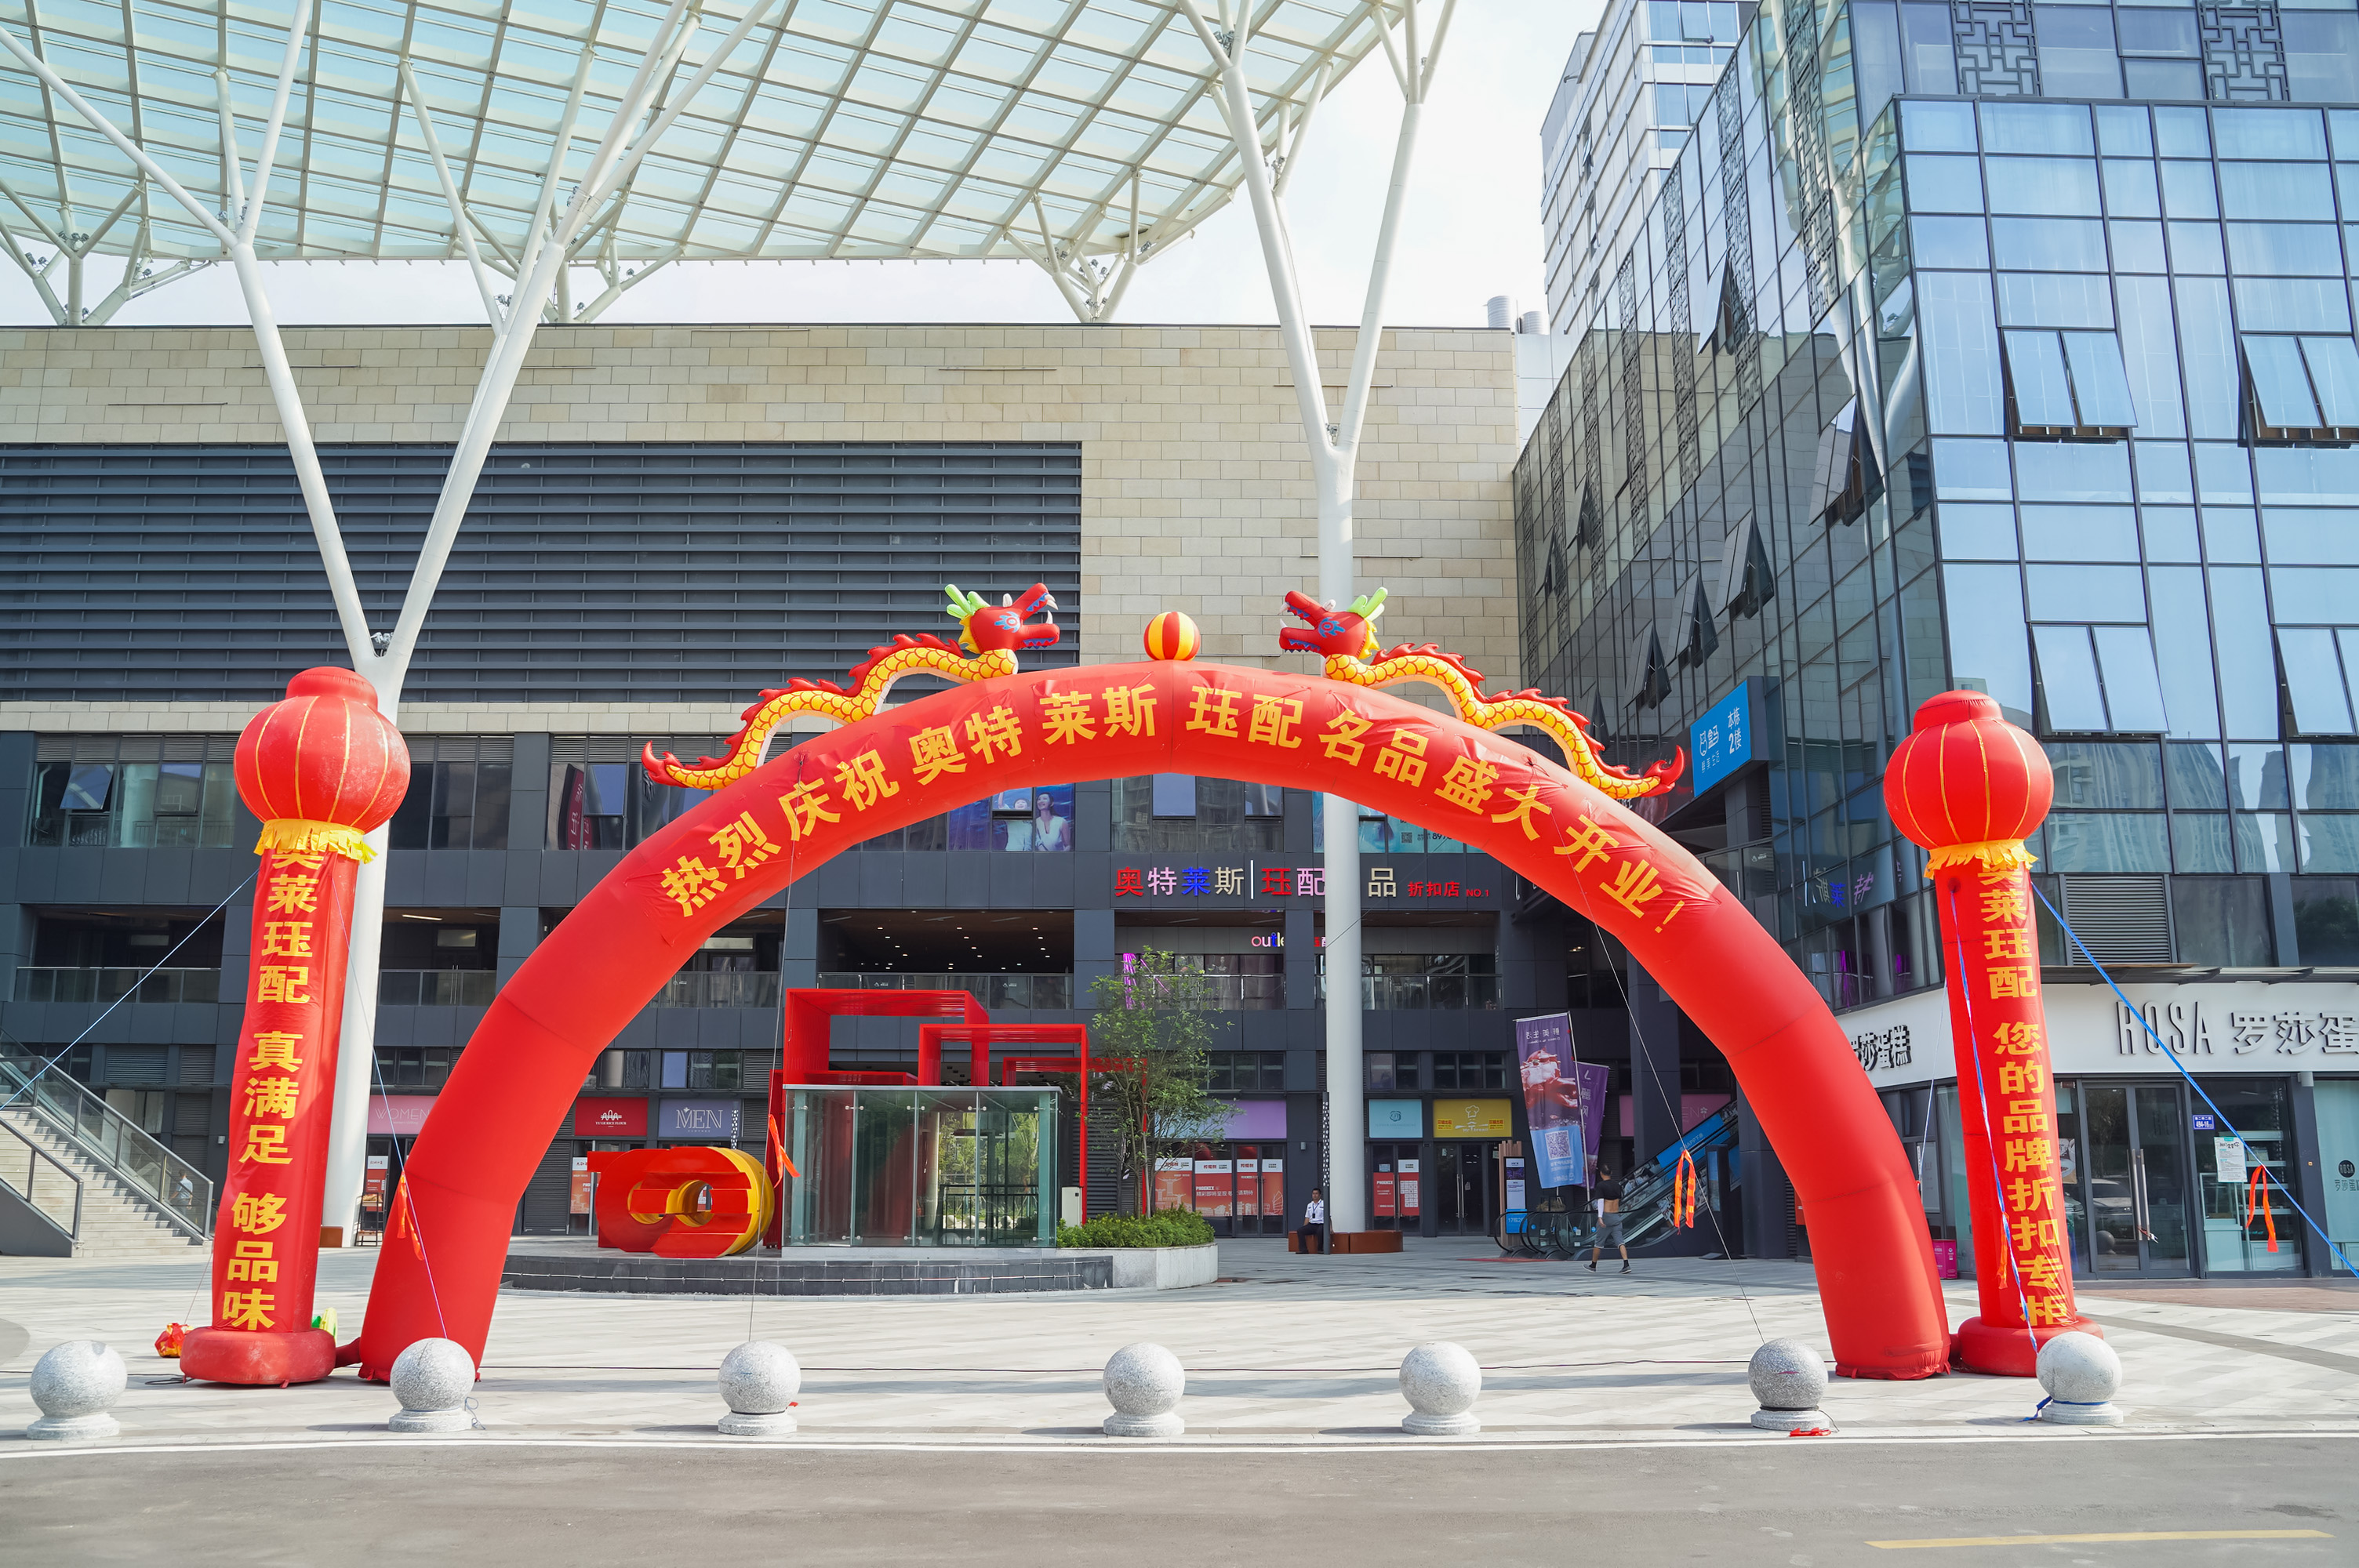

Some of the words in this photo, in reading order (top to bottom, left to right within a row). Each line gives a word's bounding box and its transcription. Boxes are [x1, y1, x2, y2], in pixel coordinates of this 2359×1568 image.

[1728, 706, 1740, 730] 本栋
[1708, 724, 1720, 750] 盒马
[1728, 728, 1742, 754] 2楼
[1114, 866, 1245, 897] 奥特莱斯
[1260, 867, 1397, 898] 珏配品
[1408, 880, 1460, 897] 折扣店
[2116, 1000, 2214, 1054] ROSA
[238, 1030, 303, 1166] 真满足
[675, 1107, 723, 1129] MEN
[222, 1192, 287, 1331] 够品味
